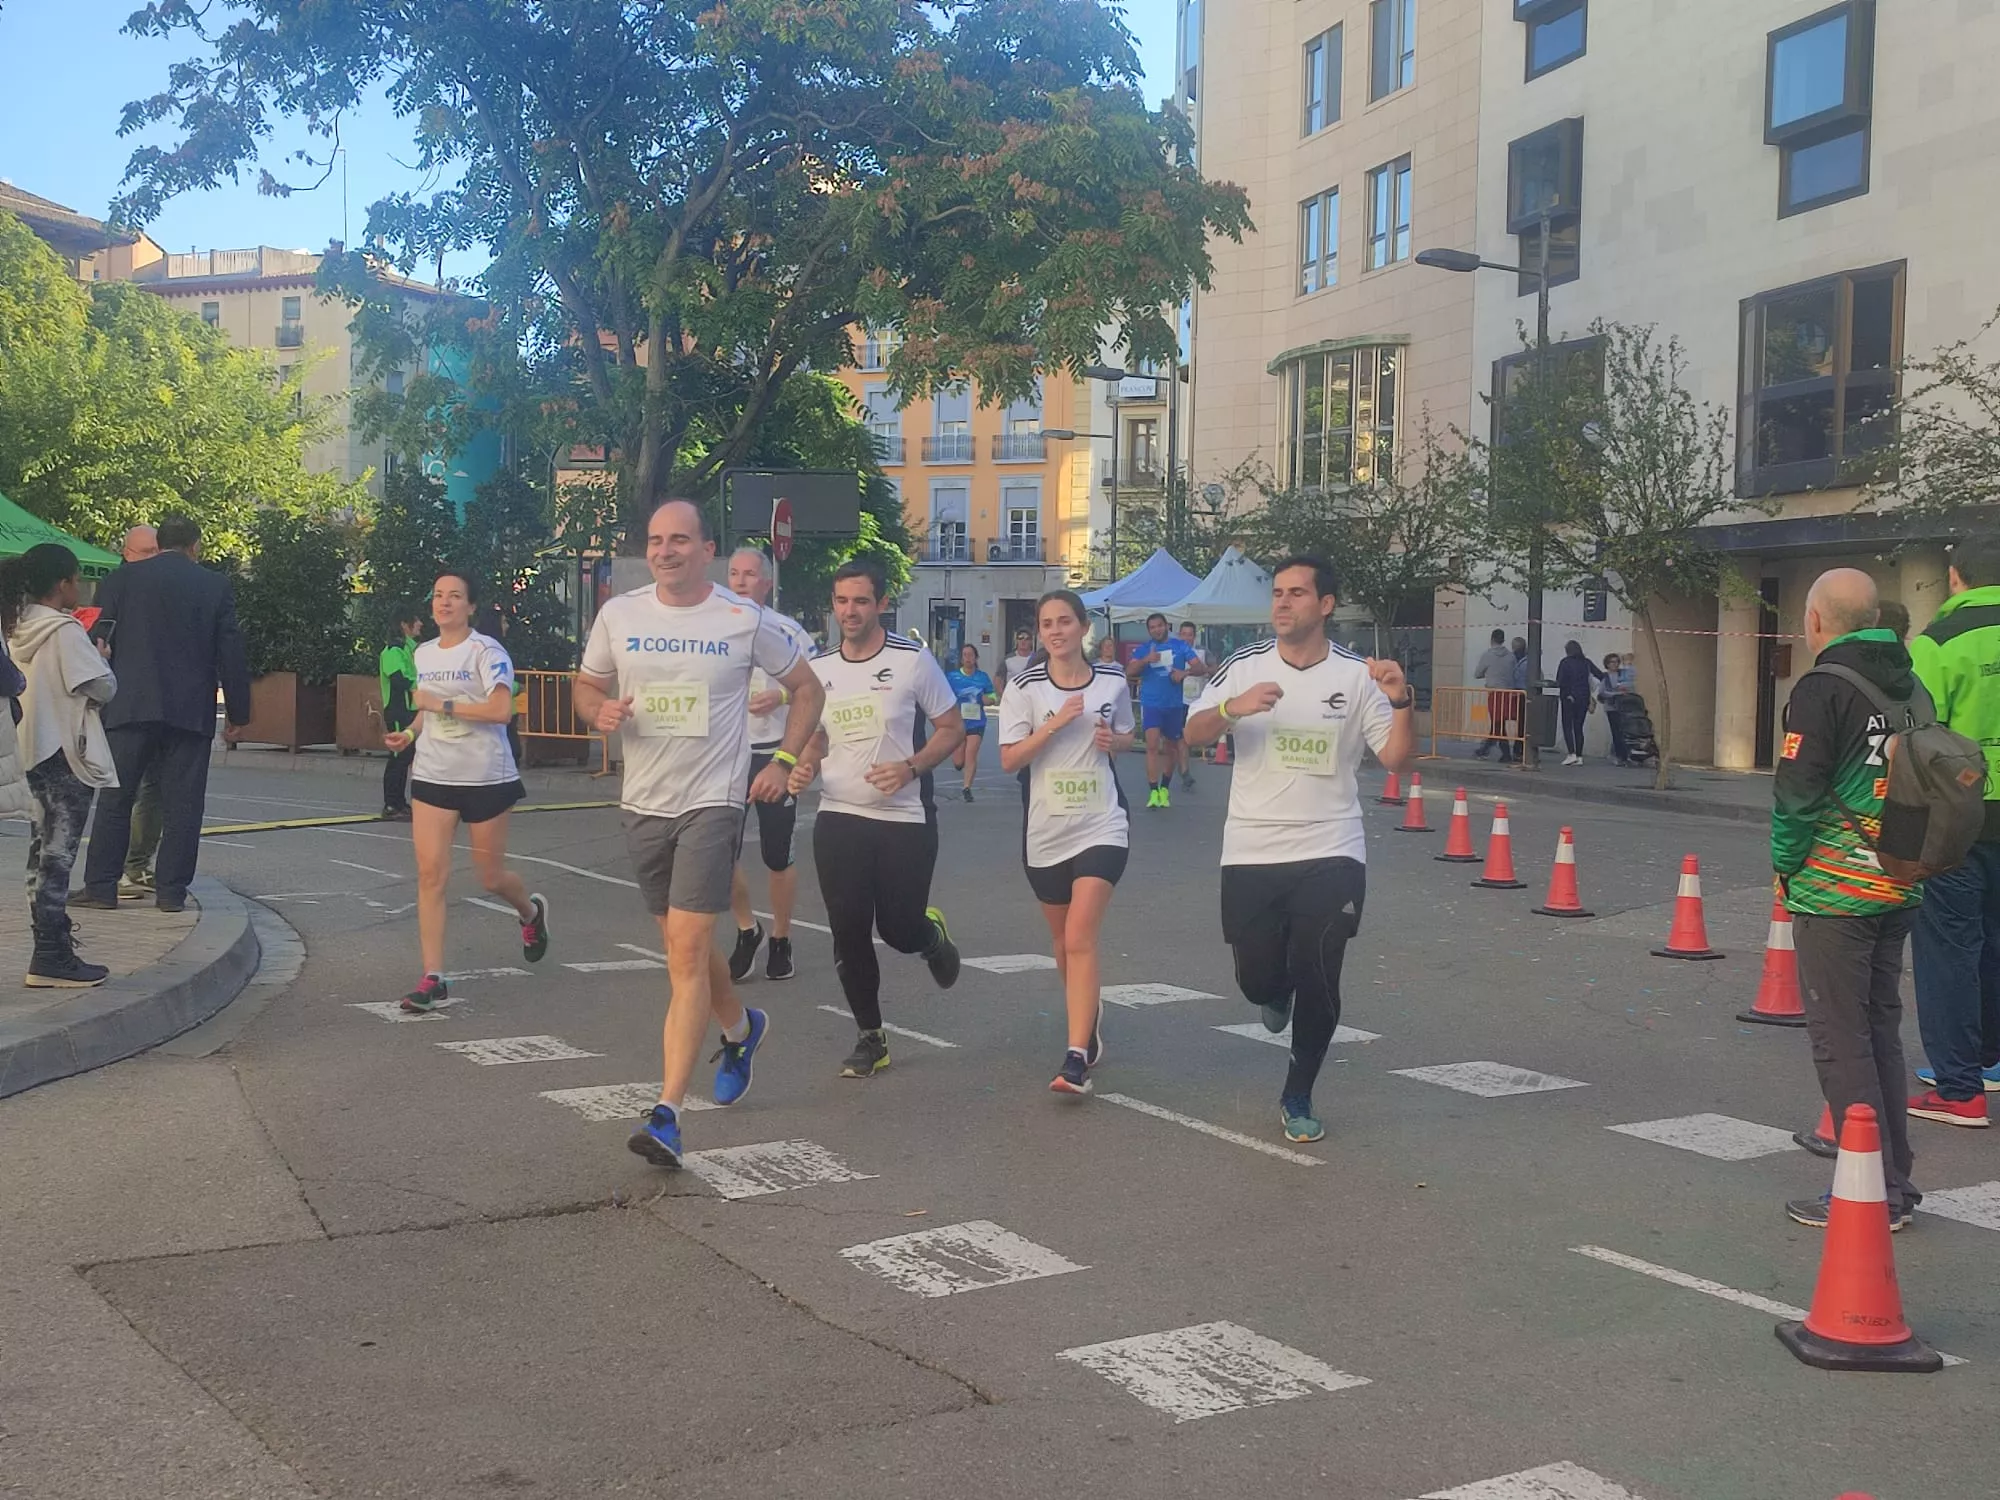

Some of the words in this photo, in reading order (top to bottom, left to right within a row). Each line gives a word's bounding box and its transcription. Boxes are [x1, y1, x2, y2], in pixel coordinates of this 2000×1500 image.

[643, 637, 730, 657] COGITIAR
[422, 670, 471, 682] COGITIAR
[645, 696, 697, 713] 3017
[832, 705, 874, 724] 3039
[1275, 736, 1328, 754] 3040
[1053, 780, 1097, 795] 3041
